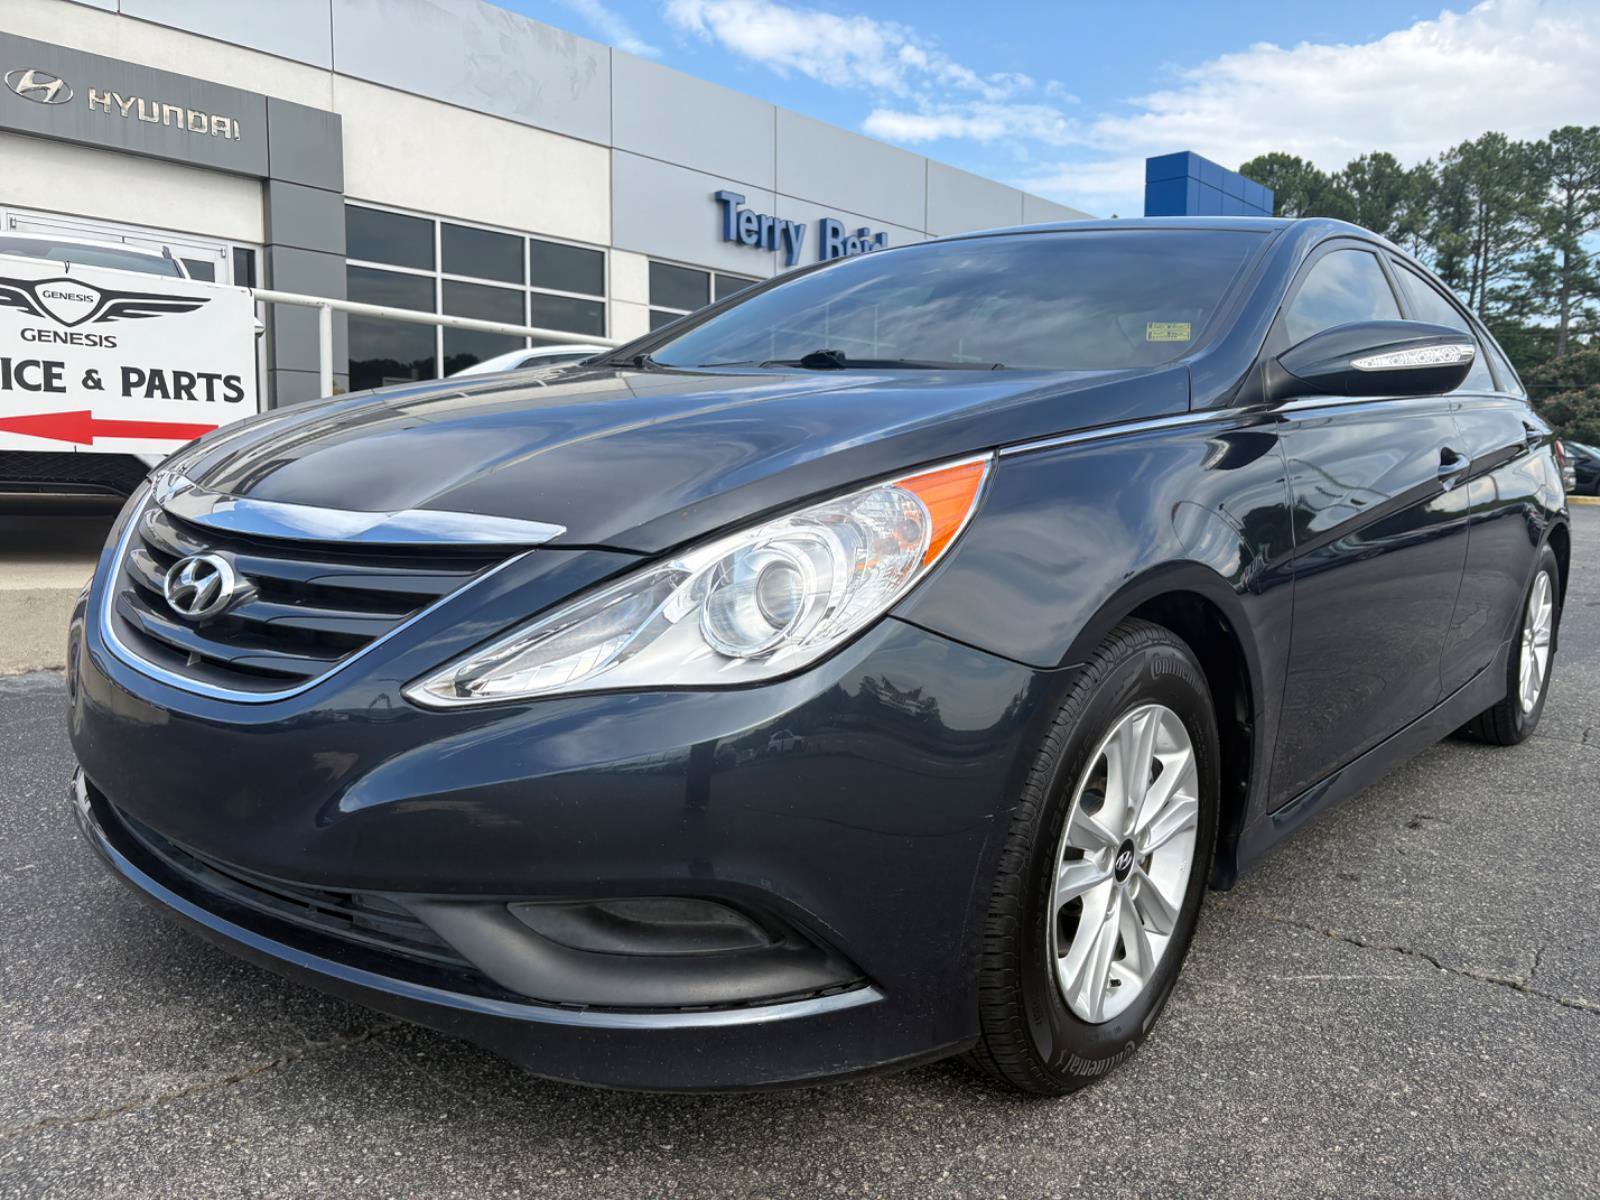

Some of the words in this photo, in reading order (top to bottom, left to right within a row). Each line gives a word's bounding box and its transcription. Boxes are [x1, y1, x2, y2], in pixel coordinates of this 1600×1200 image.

[88, 87, 241, 141] HYUNDAI
[715, 190, 806, 266] Terry
[42, 289, 94, 304] GENESIS
[20, 327, 118, 349] GENESIS
[82, 368, 105, 390] &
[121, 366, 245, 403] PARTS
